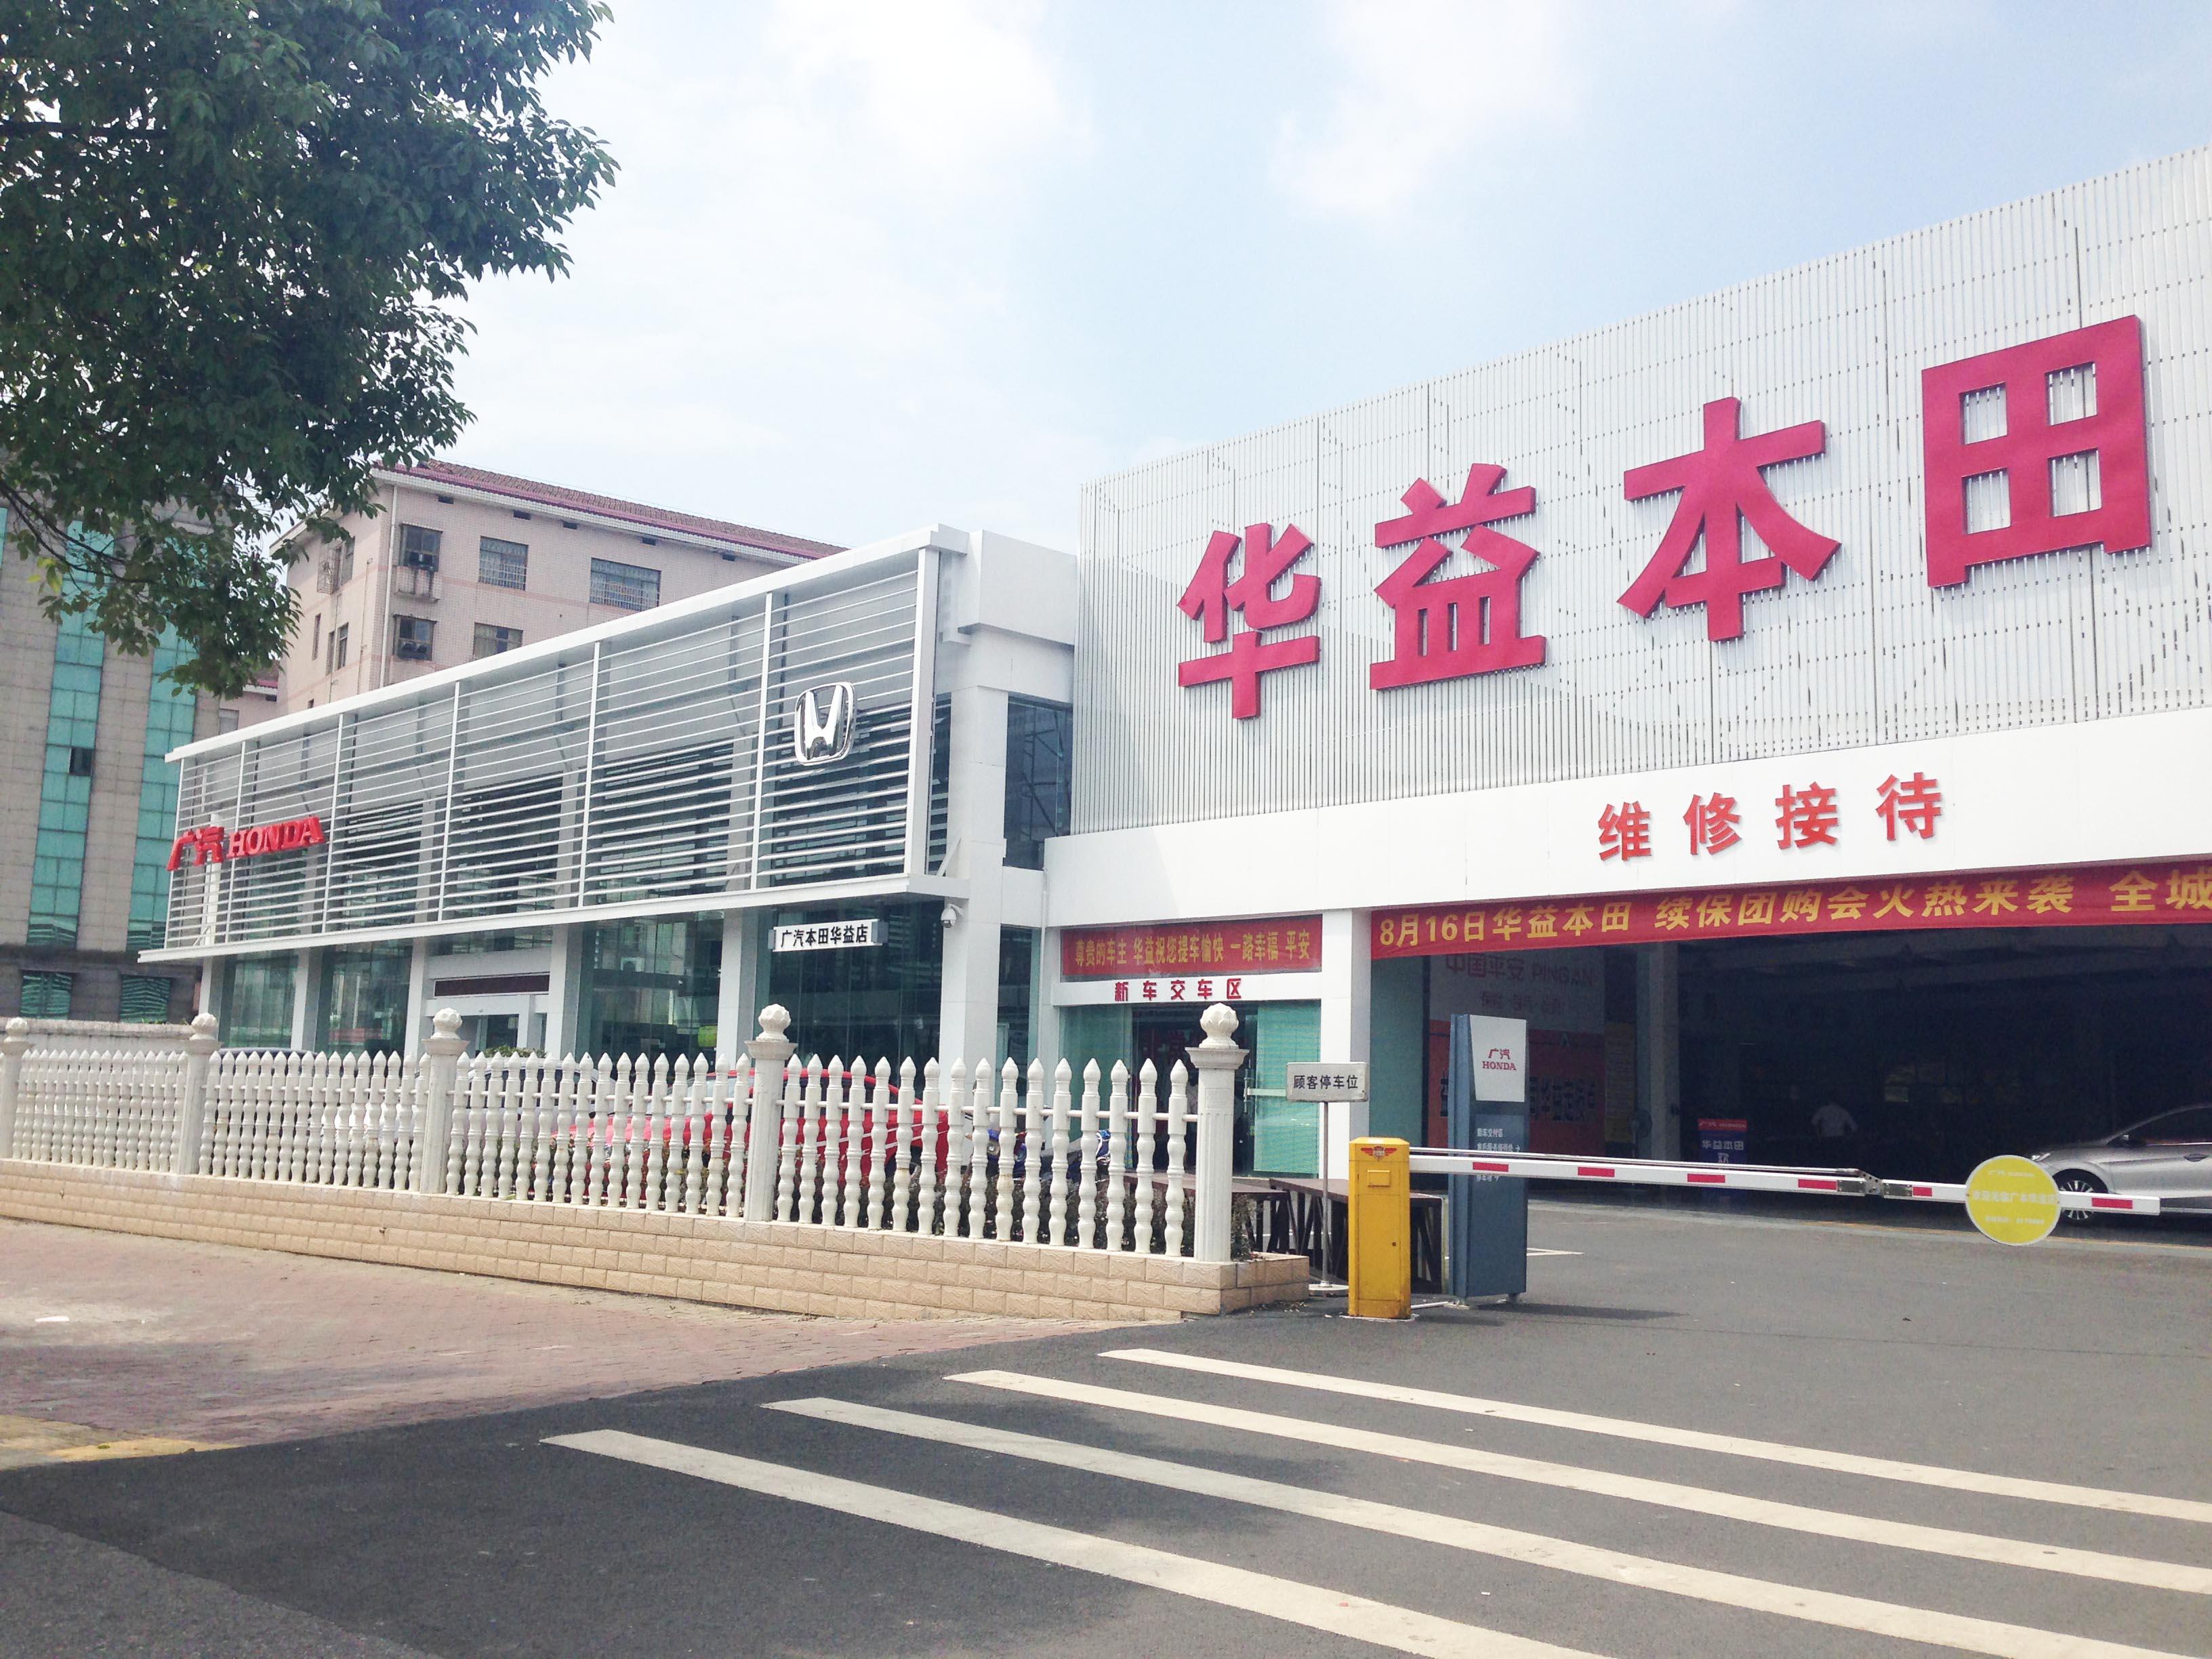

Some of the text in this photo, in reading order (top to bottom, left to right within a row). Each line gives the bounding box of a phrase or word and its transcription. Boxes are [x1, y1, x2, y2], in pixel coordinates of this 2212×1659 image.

[1178, 314, 2154, 720] 华益本田
[1598, 772, 1944, 864] 维修接待
[166, 815, 327, 872] 广汽 HONDA
[1379, 901, 1632, 947] 8月16日华益本田
[1654, 876, 2075, 931] 续保团购会火热来袭
[781, 924, 869, 948] 广汽本田华益店
[1114, 978, 1242, 1002] 新车交车区
[1482, 1061, 1517, 1071] HONDA
[1488, 1048, 1511, 1060] 广汽
[1293, 1074, 1358, 1090] 顾客停车位
